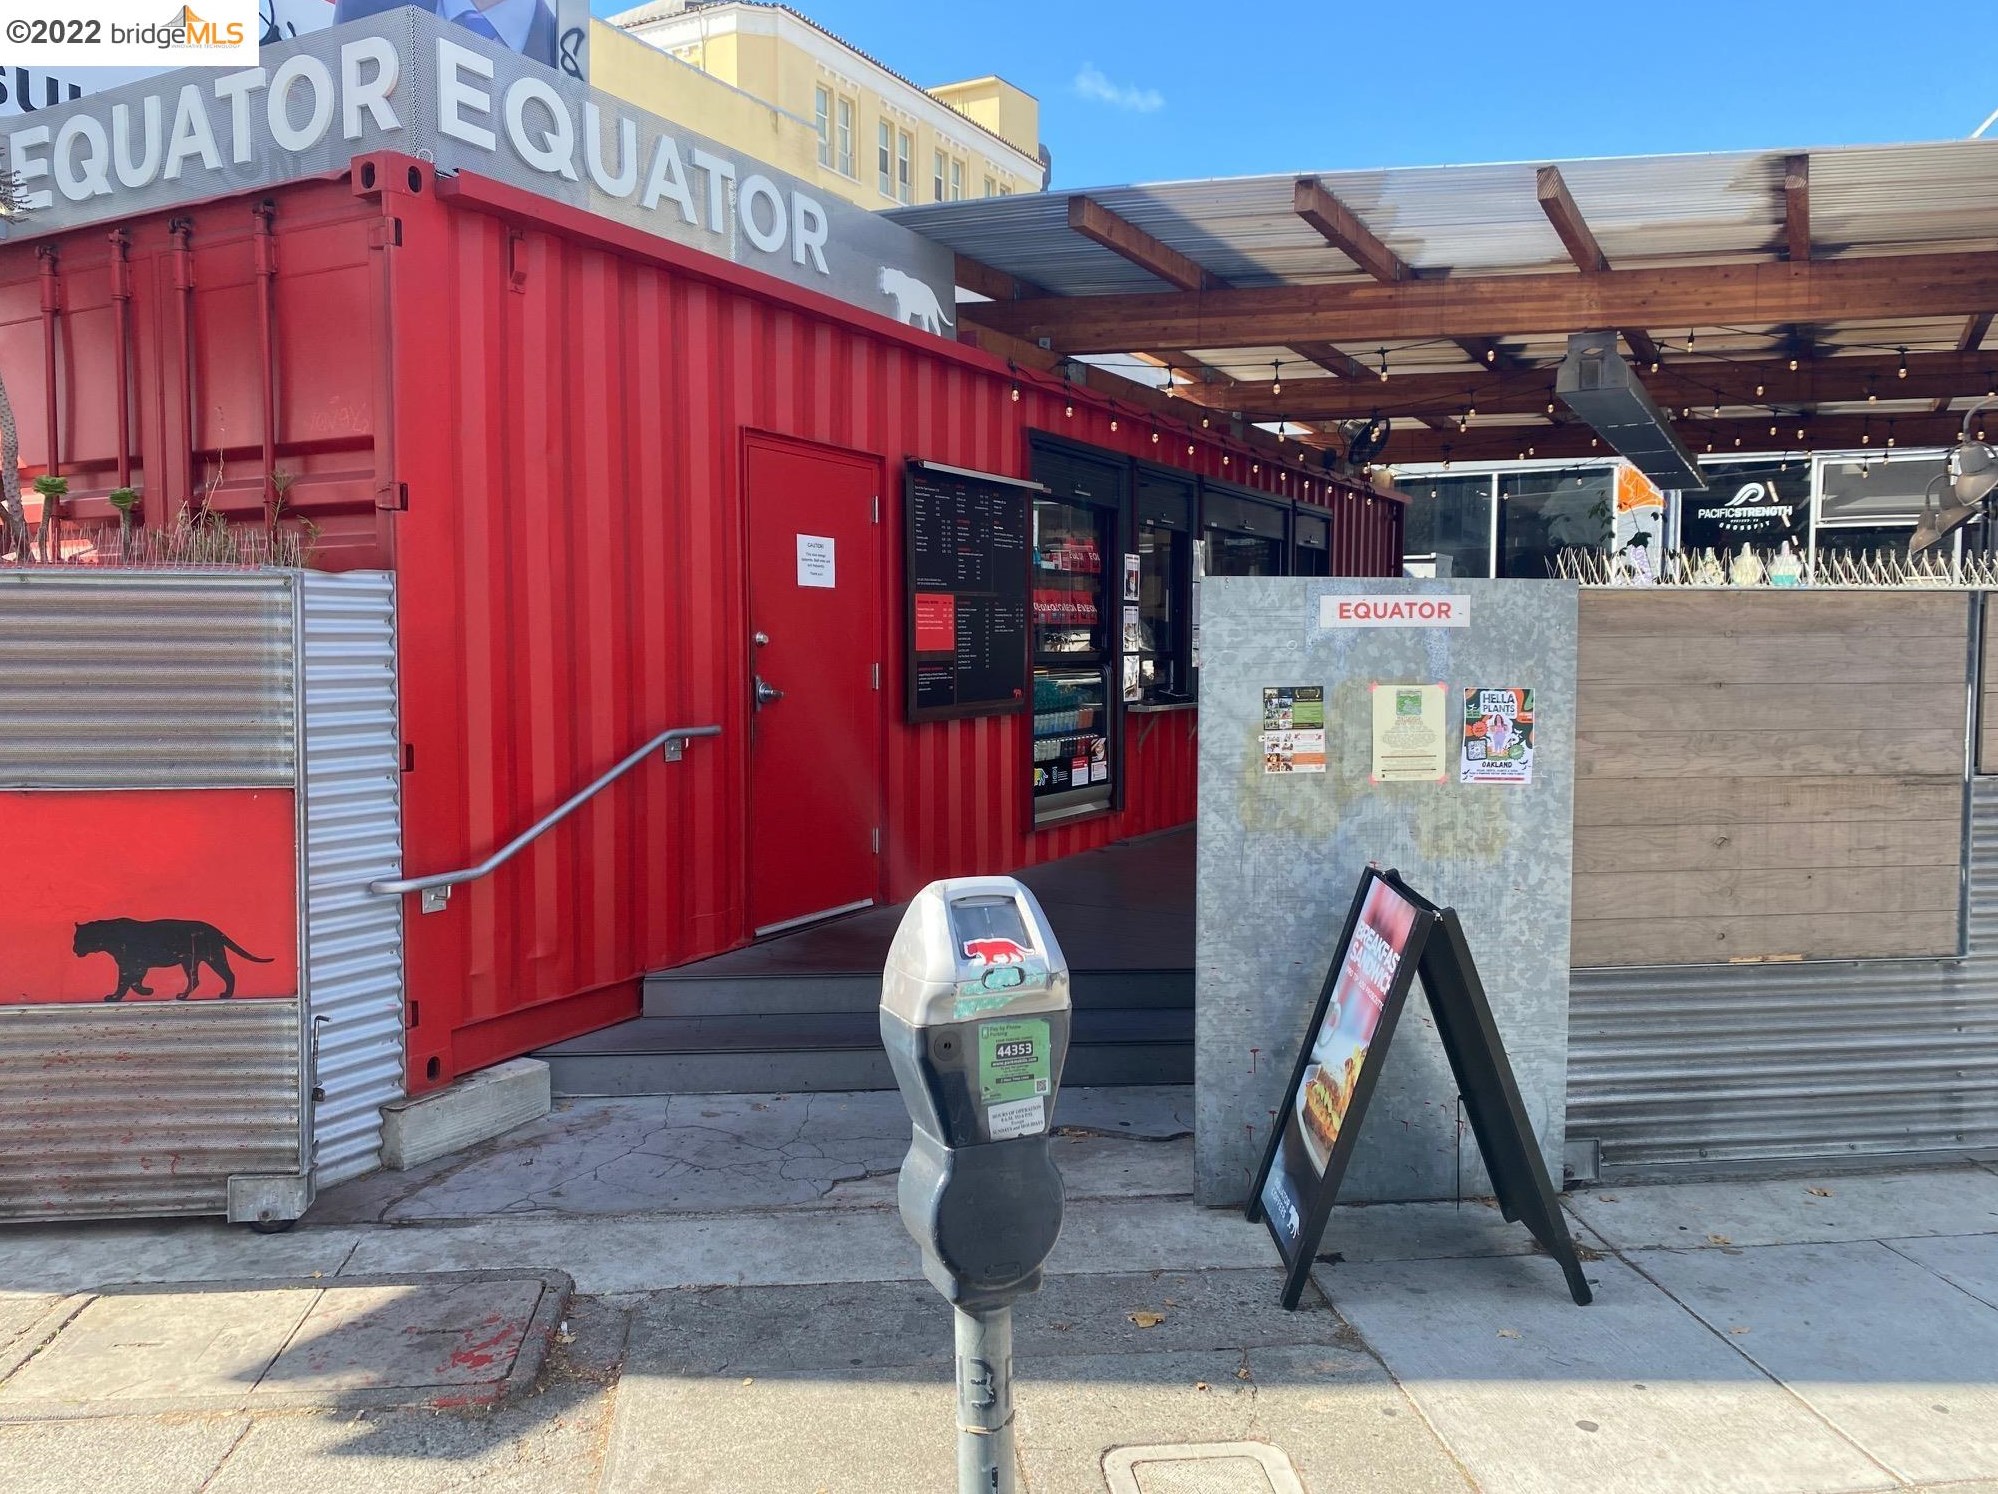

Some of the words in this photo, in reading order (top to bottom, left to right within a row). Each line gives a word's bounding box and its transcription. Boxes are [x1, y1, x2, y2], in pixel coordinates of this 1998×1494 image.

[10, 36, 402, 210] EQUATOR
[435, 37, 829, 275] EQUATOR
[1719, 520, 1770, 531] CROSSFIT
[1339, 602, 1451, 619] EQUATOR
[1482, 693, 1515, 704] HELLA
[1482, 704, 1515, 713] PLANTS
[997, 1043, 1032, 1058] 44353
